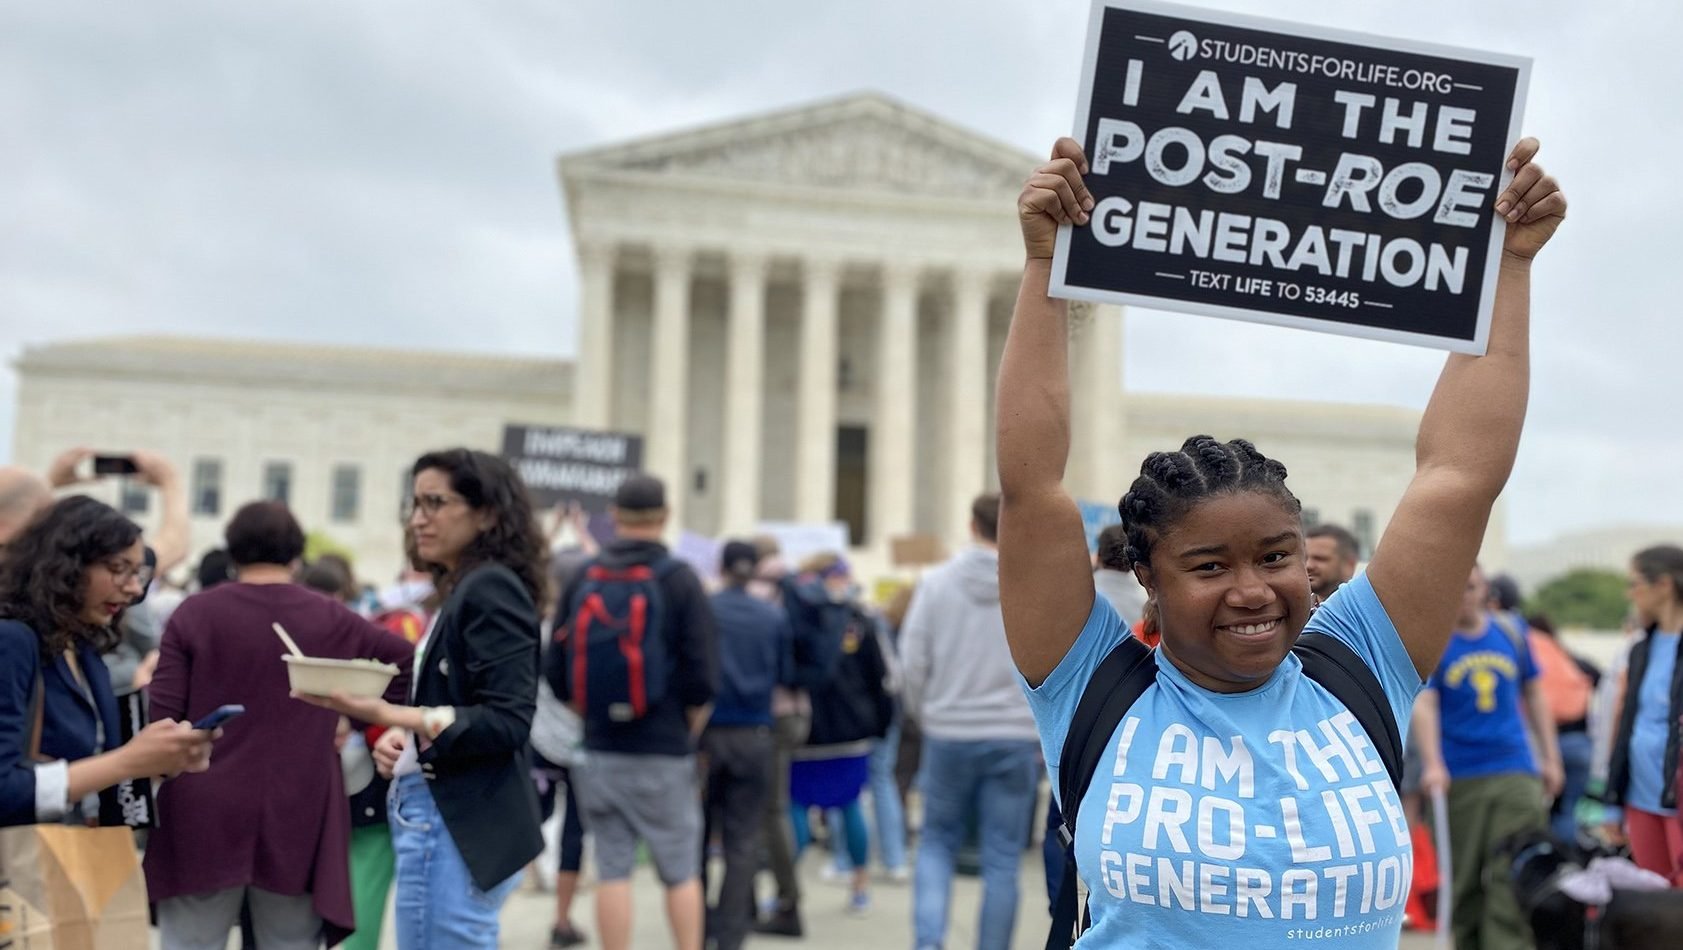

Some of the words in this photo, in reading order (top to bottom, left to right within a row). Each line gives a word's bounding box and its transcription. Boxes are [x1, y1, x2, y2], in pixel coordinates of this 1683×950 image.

[1122, 58, 1144, 107] I
[1175, 69, 1298, 130] AM
[1334, 89, 1478, 156] THE
[1200, 38, 1454, 95] STUDENTSFORLIFE.ORG
[1091, 117, 1495, 229] POST-ROE
[1091, 196, 1469, 295] GENERATION
[1190, 270, 1232, 291] TEXT
[1235, 276, 1273, 297] LIFE
[1277, 281, 1301, 300] TO
[1304, 286, 1360, 309] 53445
[1112, 716, 1141, 777] I
[1152, 723, 1255, 798] AM
[1267, 709, 1383, 791] THE
[1101, 772, 1412, 863] PRO-LIFE
